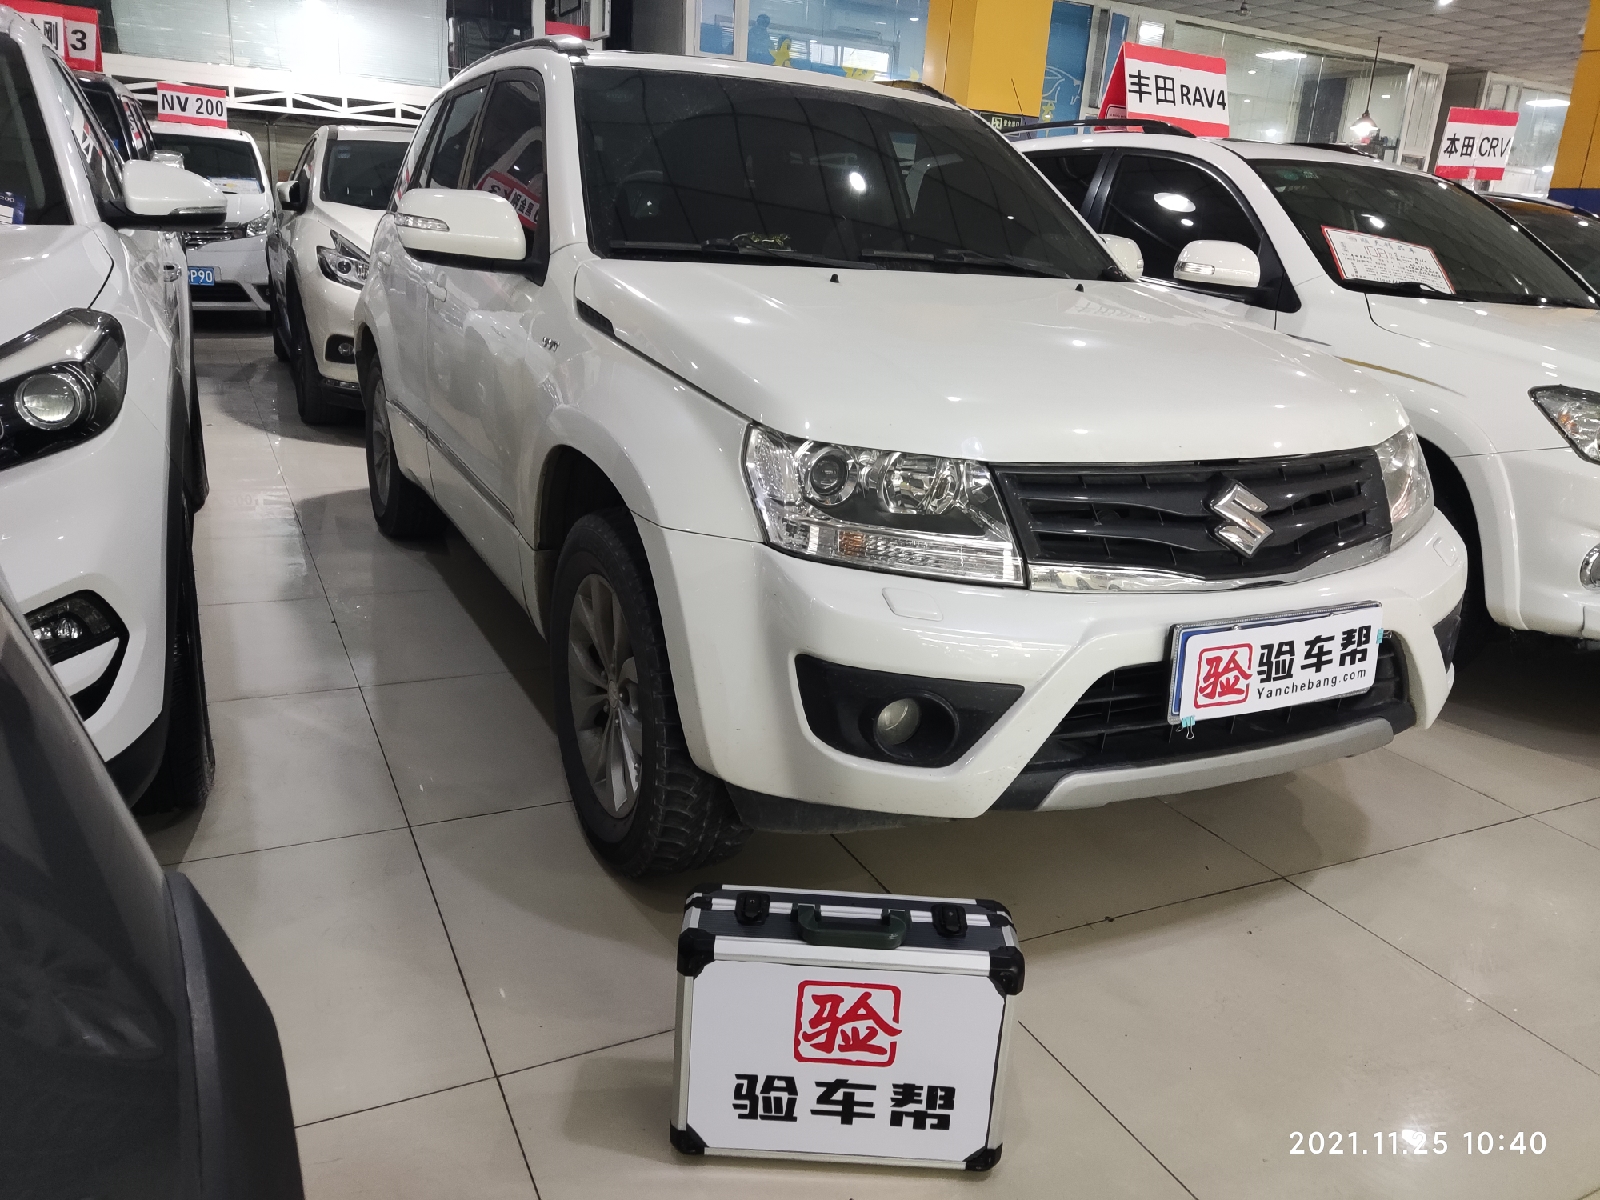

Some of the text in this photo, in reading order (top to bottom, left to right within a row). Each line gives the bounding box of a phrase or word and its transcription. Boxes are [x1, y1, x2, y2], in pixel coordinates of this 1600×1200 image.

[70, 29, 87, 51] 3
[161, 93, 224, 117] NV 200
[1128, 69, 1226, 111] 丰田 RAV4
[1443, 133, 1511, 158] 本田 CRV
[188, 269, 213, 283] P90
[1257, 625, 1372, 684] 验车帮
[1199, 650, 1253, 700] 验
[1257, 668, 1367, 700] Yanchebang.com
[801, 991, 903, 1056] 验
[732, 1073, 956, 1131] 验车帮
